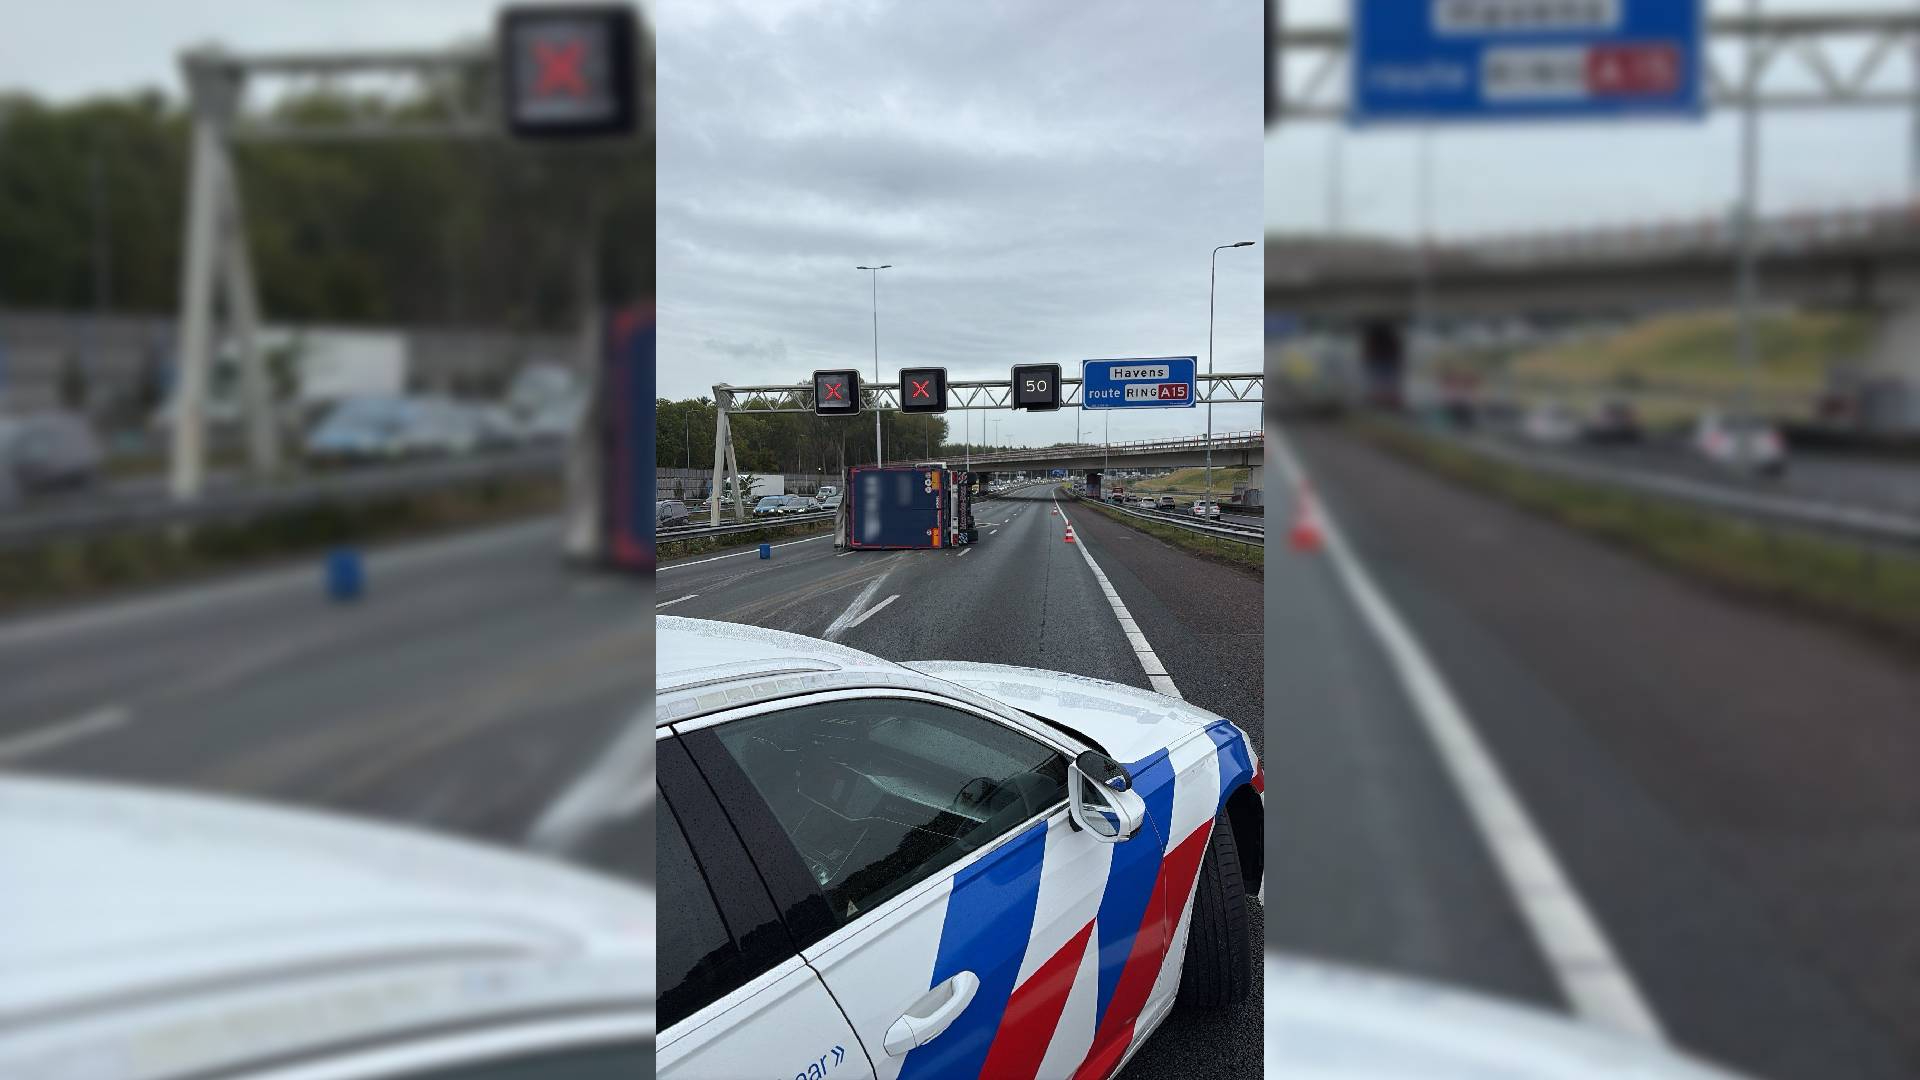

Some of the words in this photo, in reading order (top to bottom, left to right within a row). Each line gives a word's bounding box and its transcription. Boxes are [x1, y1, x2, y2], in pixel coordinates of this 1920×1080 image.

[1114, 369, 1164, 378] Havens
[1026, 380, 1047, 392] 50
[1089, 388, 1120, 399] route
[1126, 388, 1157, 398] RING
[1161, 386, 1185, 398] A15
